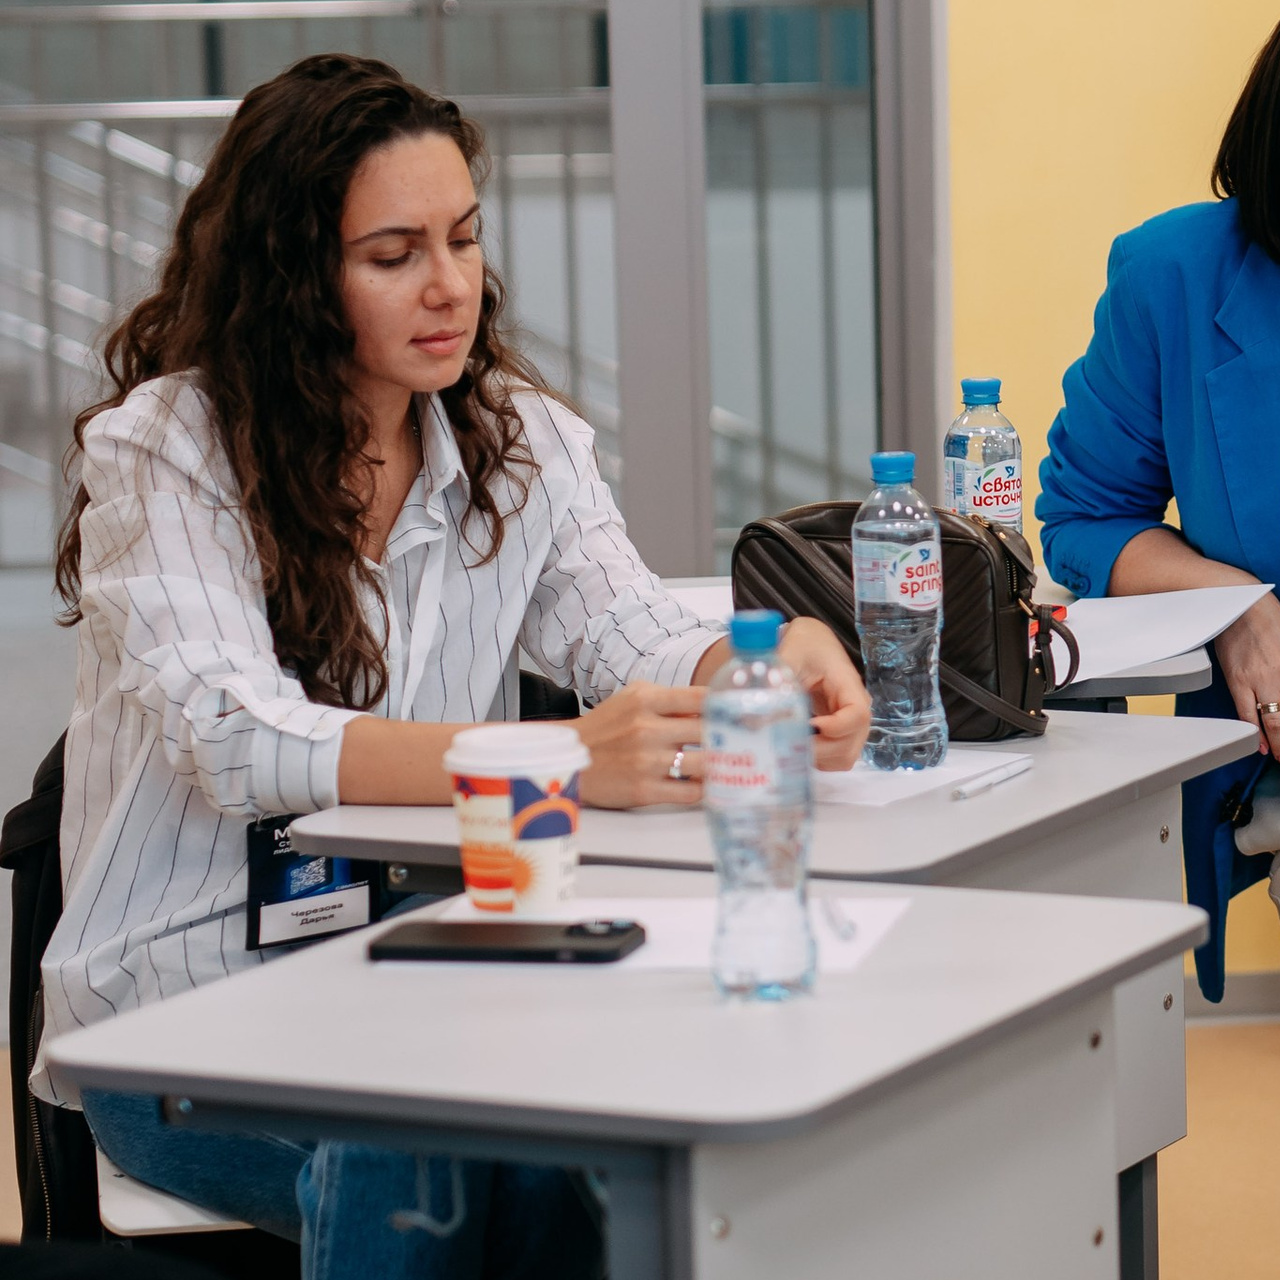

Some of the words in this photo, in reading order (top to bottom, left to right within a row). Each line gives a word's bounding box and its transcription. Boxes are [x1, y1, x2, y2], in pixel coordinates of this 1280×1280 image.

[982, 476, 1022, 493] свято
[972, 491, 1022, 507] источн
[291, 902, 344, 918] Черезова
